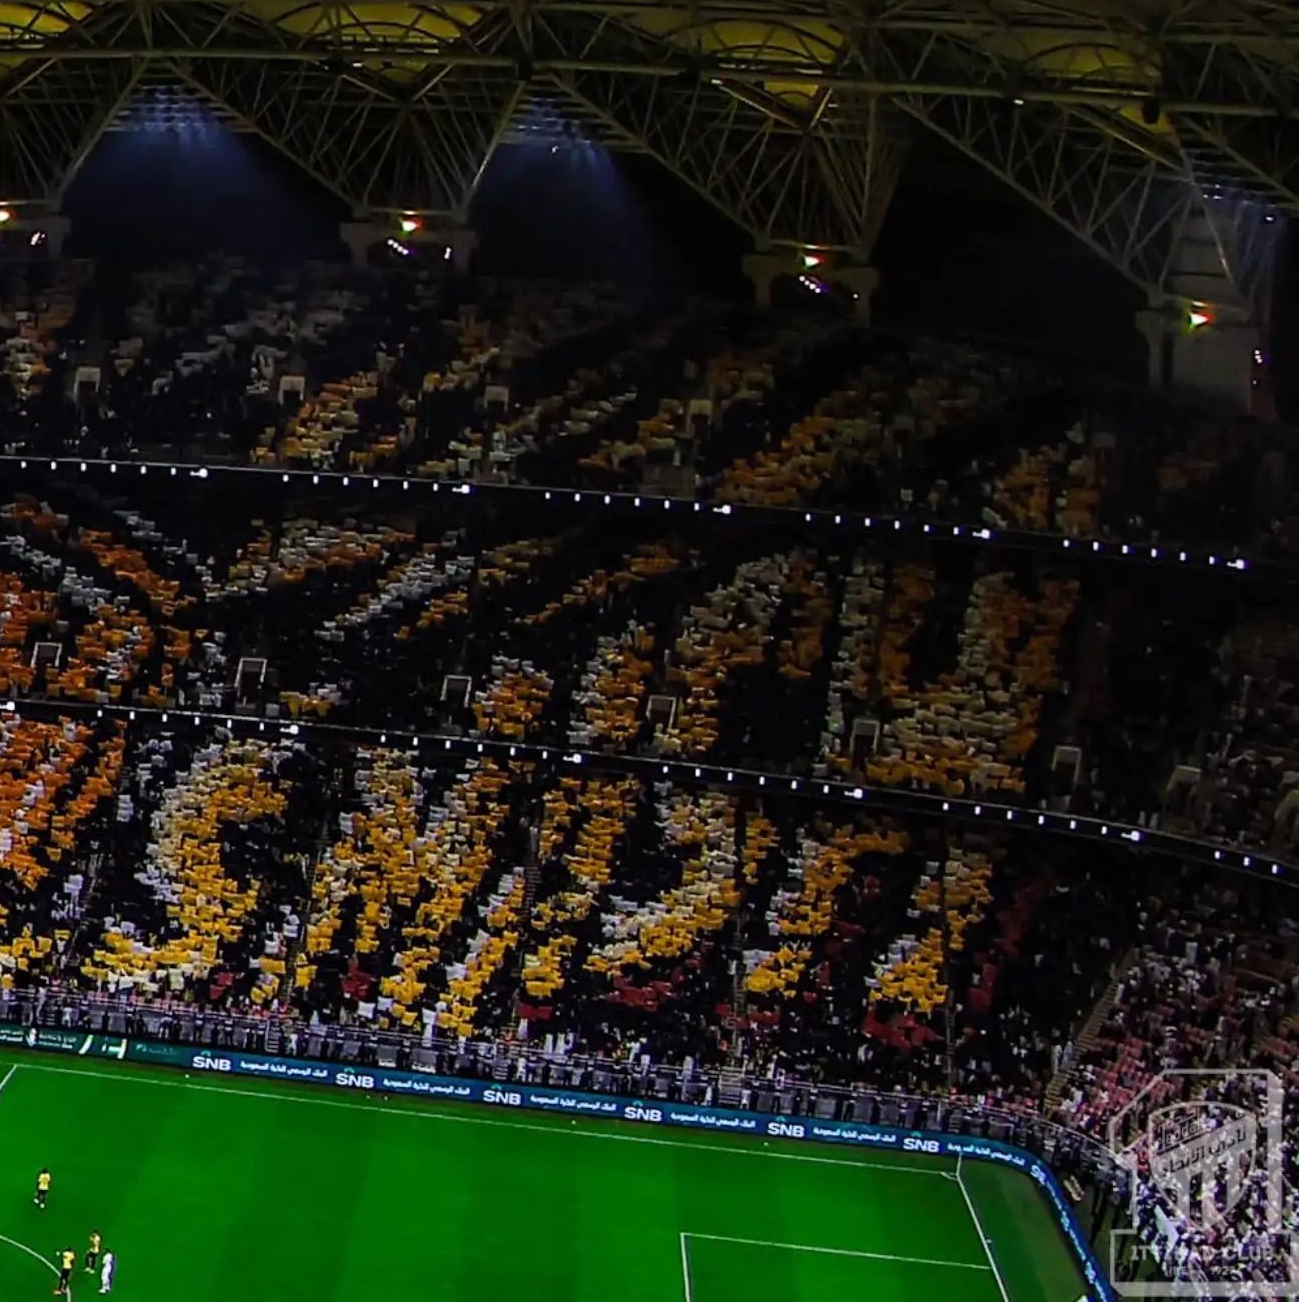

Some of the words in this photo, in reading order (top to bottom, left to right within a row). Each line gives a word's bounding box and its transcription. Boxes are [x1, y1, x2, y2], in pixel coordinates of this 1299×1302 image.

[193, 1056, 232, 1070] SNB
[336, 1072, 375, 1088] SNB
[483, 1090, 522, 1105] SNB
[625, 1107, 663, 1121] SNB
[768, 1123, 806, 1137] SNB
[903, 1138, 940, 1152] SNB
